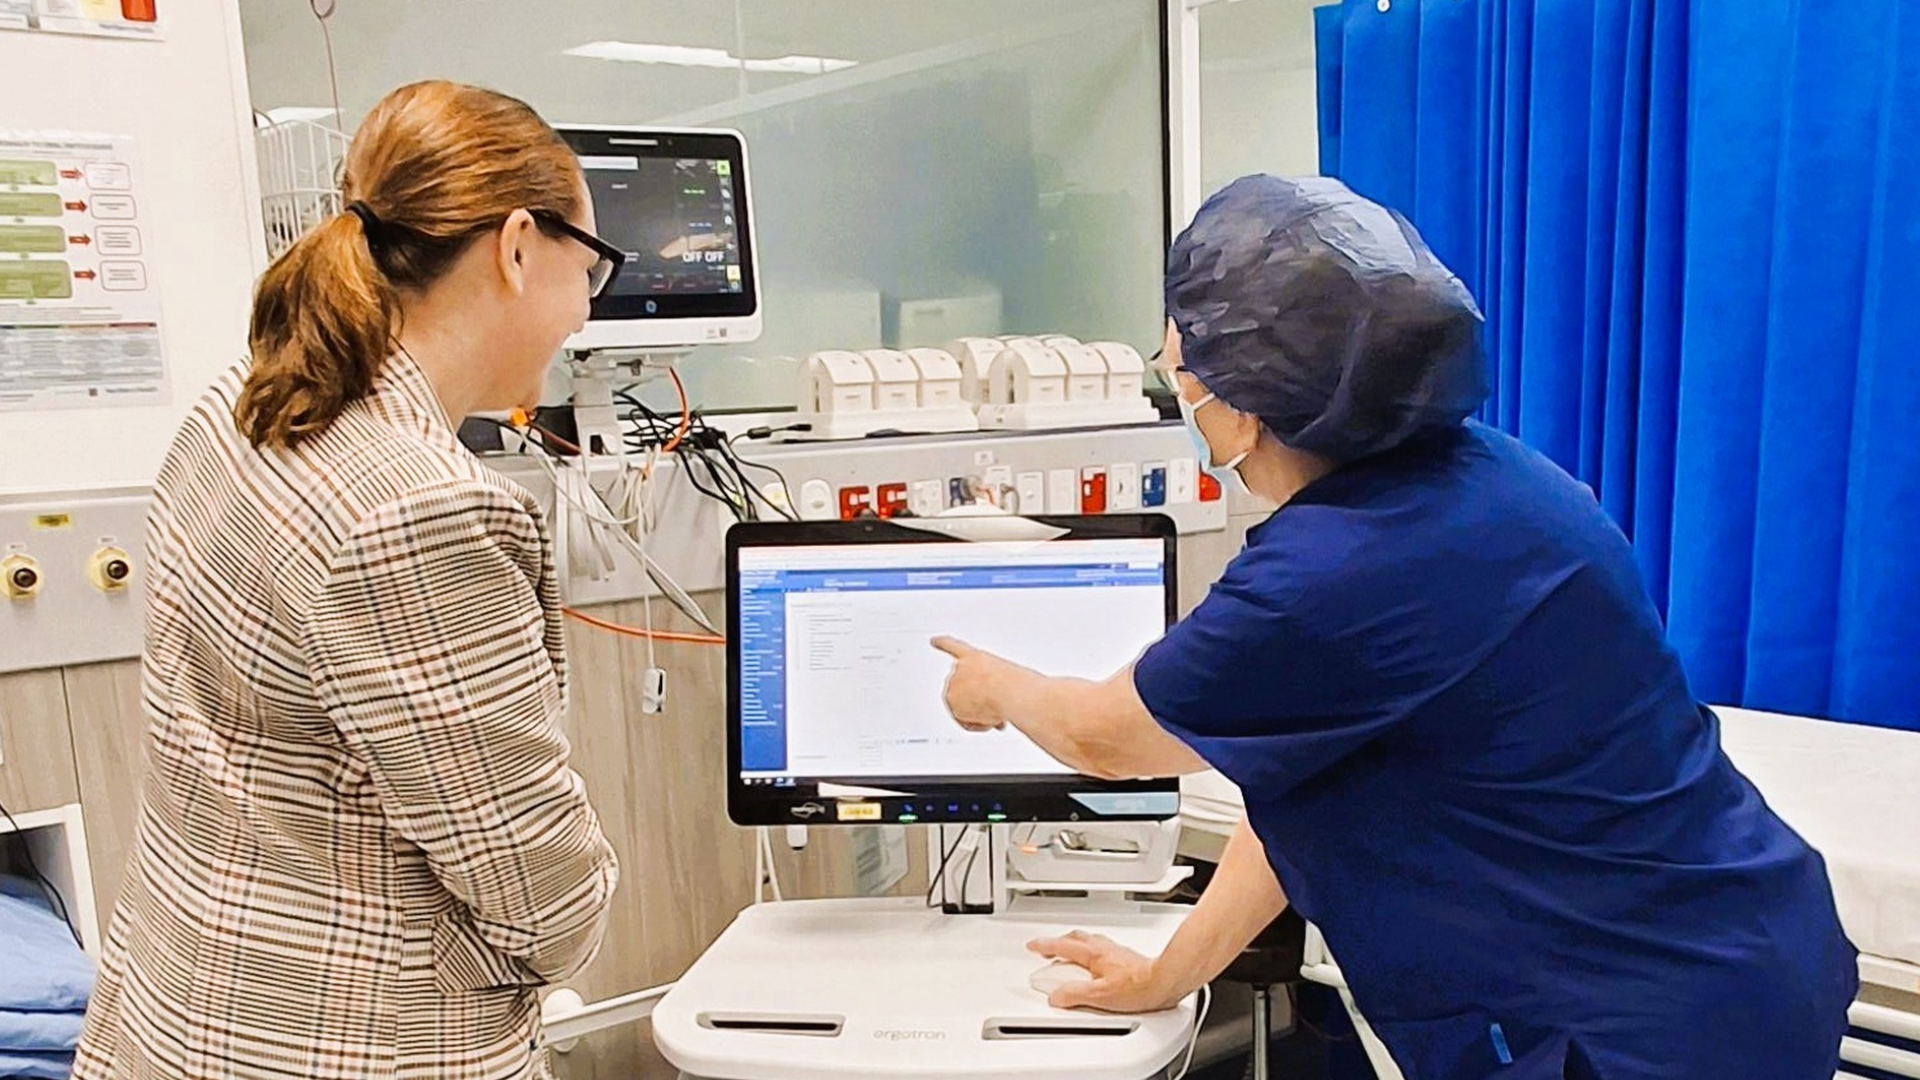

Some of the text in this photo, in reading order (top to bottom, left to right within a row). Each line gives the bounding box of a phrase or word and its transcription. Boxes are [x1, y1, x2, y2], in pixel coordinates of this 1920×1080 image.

[683, 251, 724, 262] OFF OFF
[873, 1028, 946, 1041] ergotron
